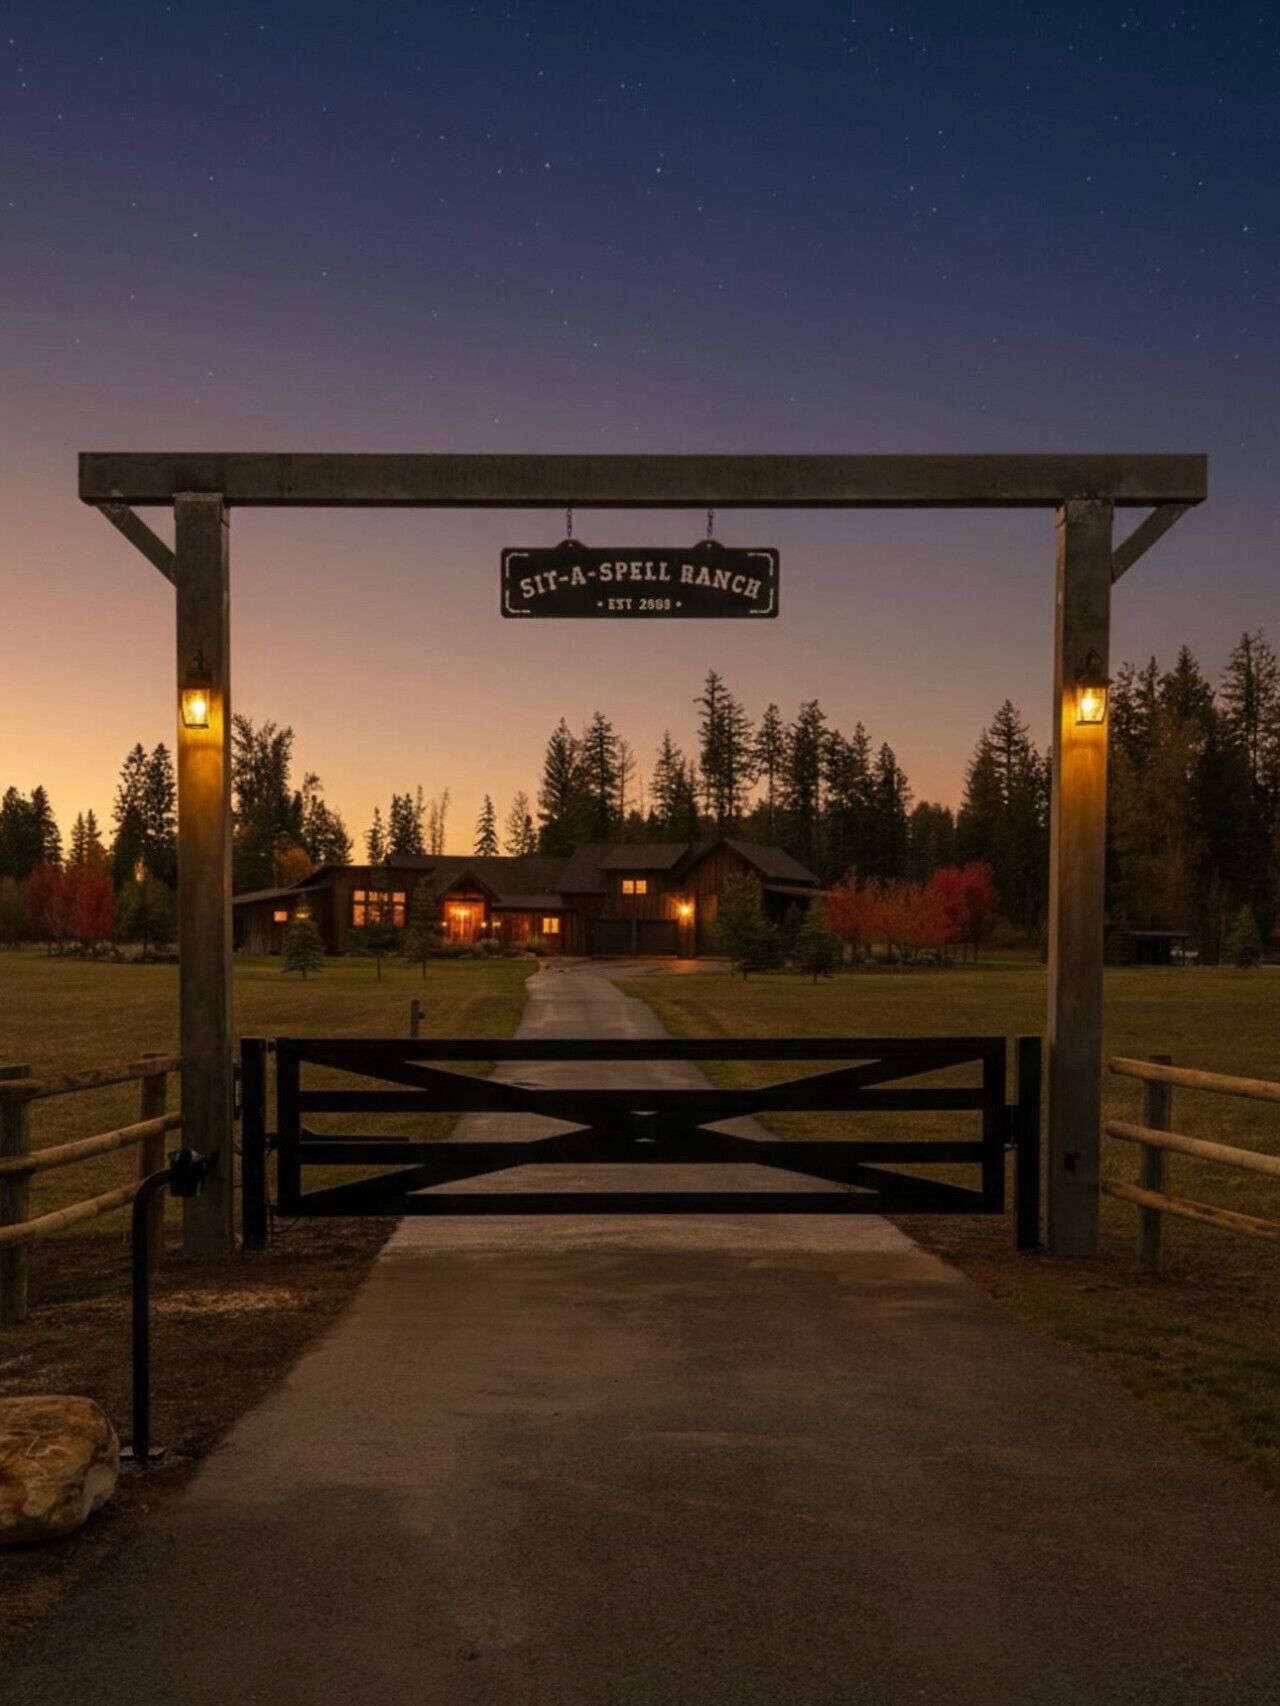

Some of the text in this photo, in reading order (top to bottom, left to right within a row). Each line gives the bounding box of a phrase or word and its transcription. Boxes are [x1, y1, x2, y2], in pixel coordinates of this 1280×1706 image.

[520, 561, 762, 599] SIT-A-SPELL RANCH
[608, 598, 632, 610] EST
